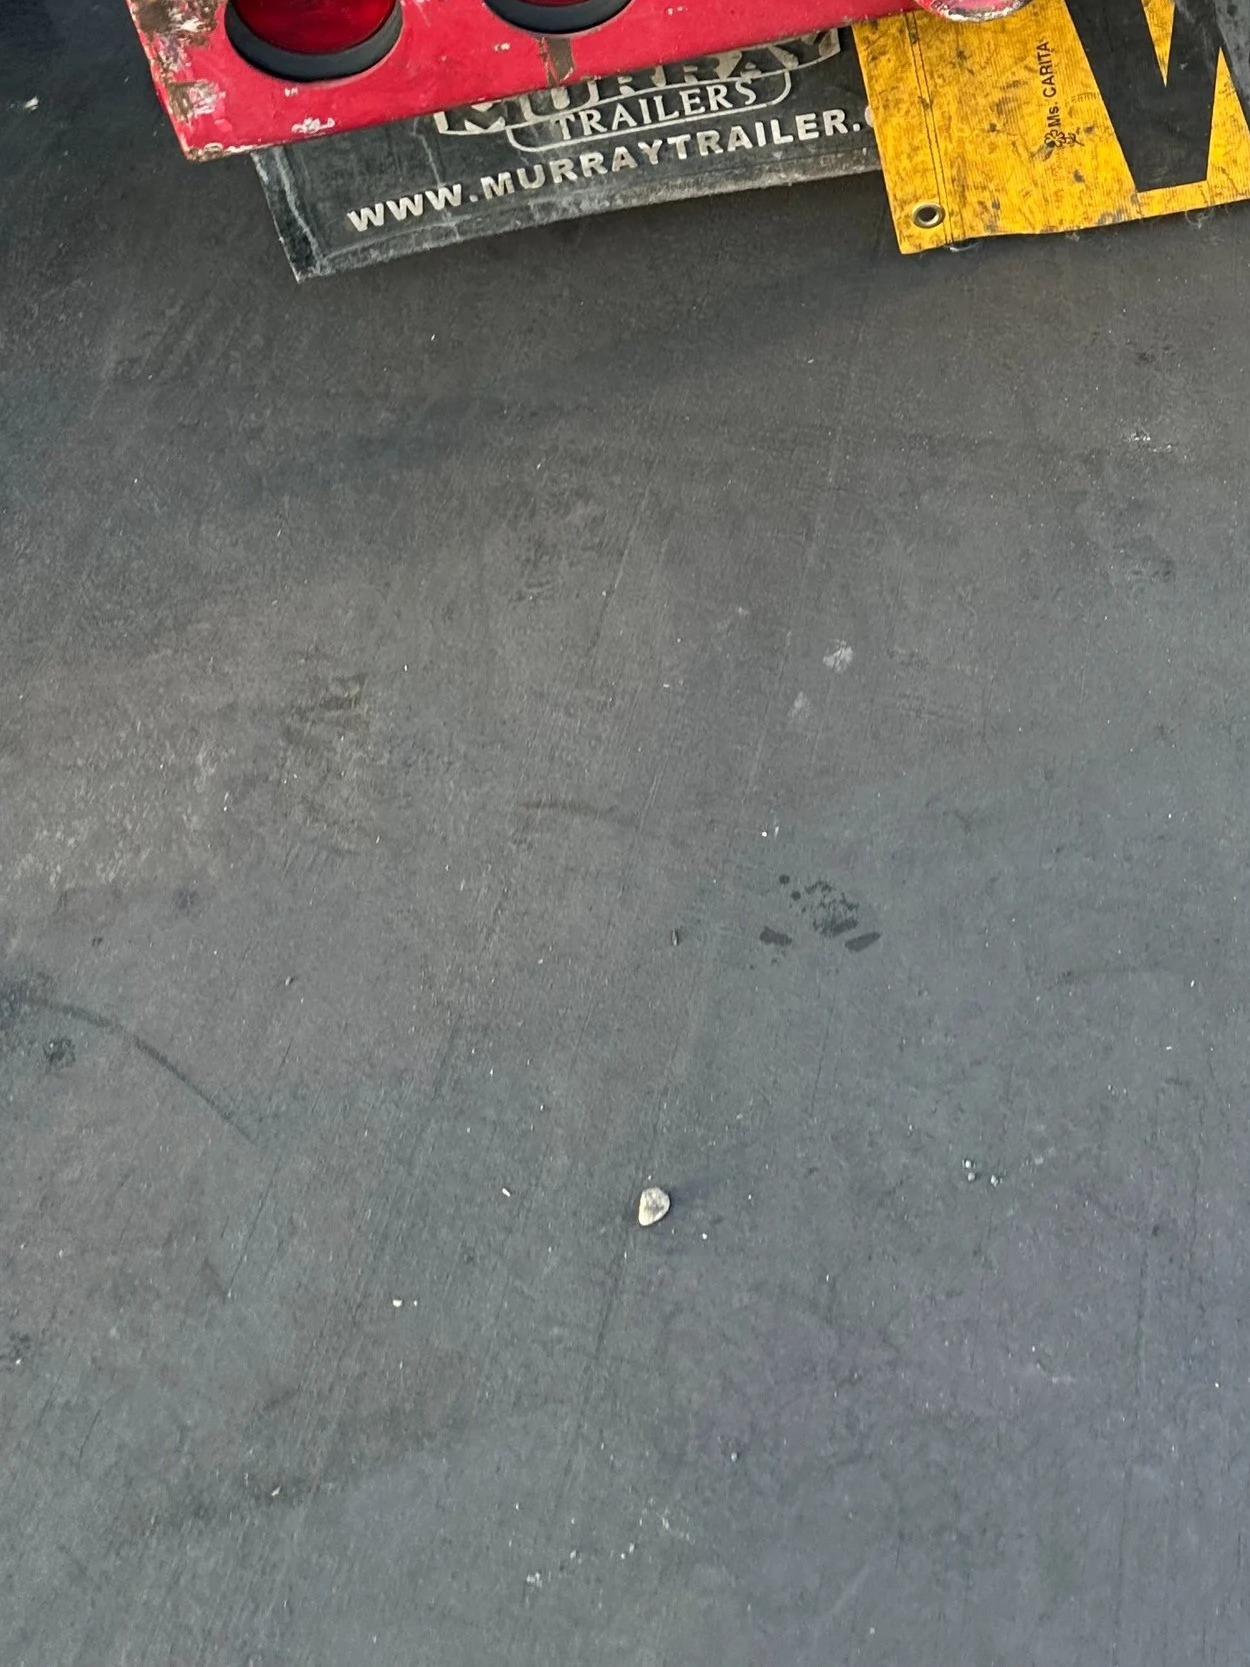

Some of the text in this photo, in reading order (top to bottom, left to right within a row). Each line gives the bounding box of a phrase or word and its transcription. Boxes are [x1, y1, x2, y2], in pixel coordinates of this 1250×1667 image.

[554, 79, 757, 141] TRAILERS
[1036, 41, 1061, 128] Ms. CARITA
[346, 106, 872, 232] WWW.MURRAYTRAILER.
